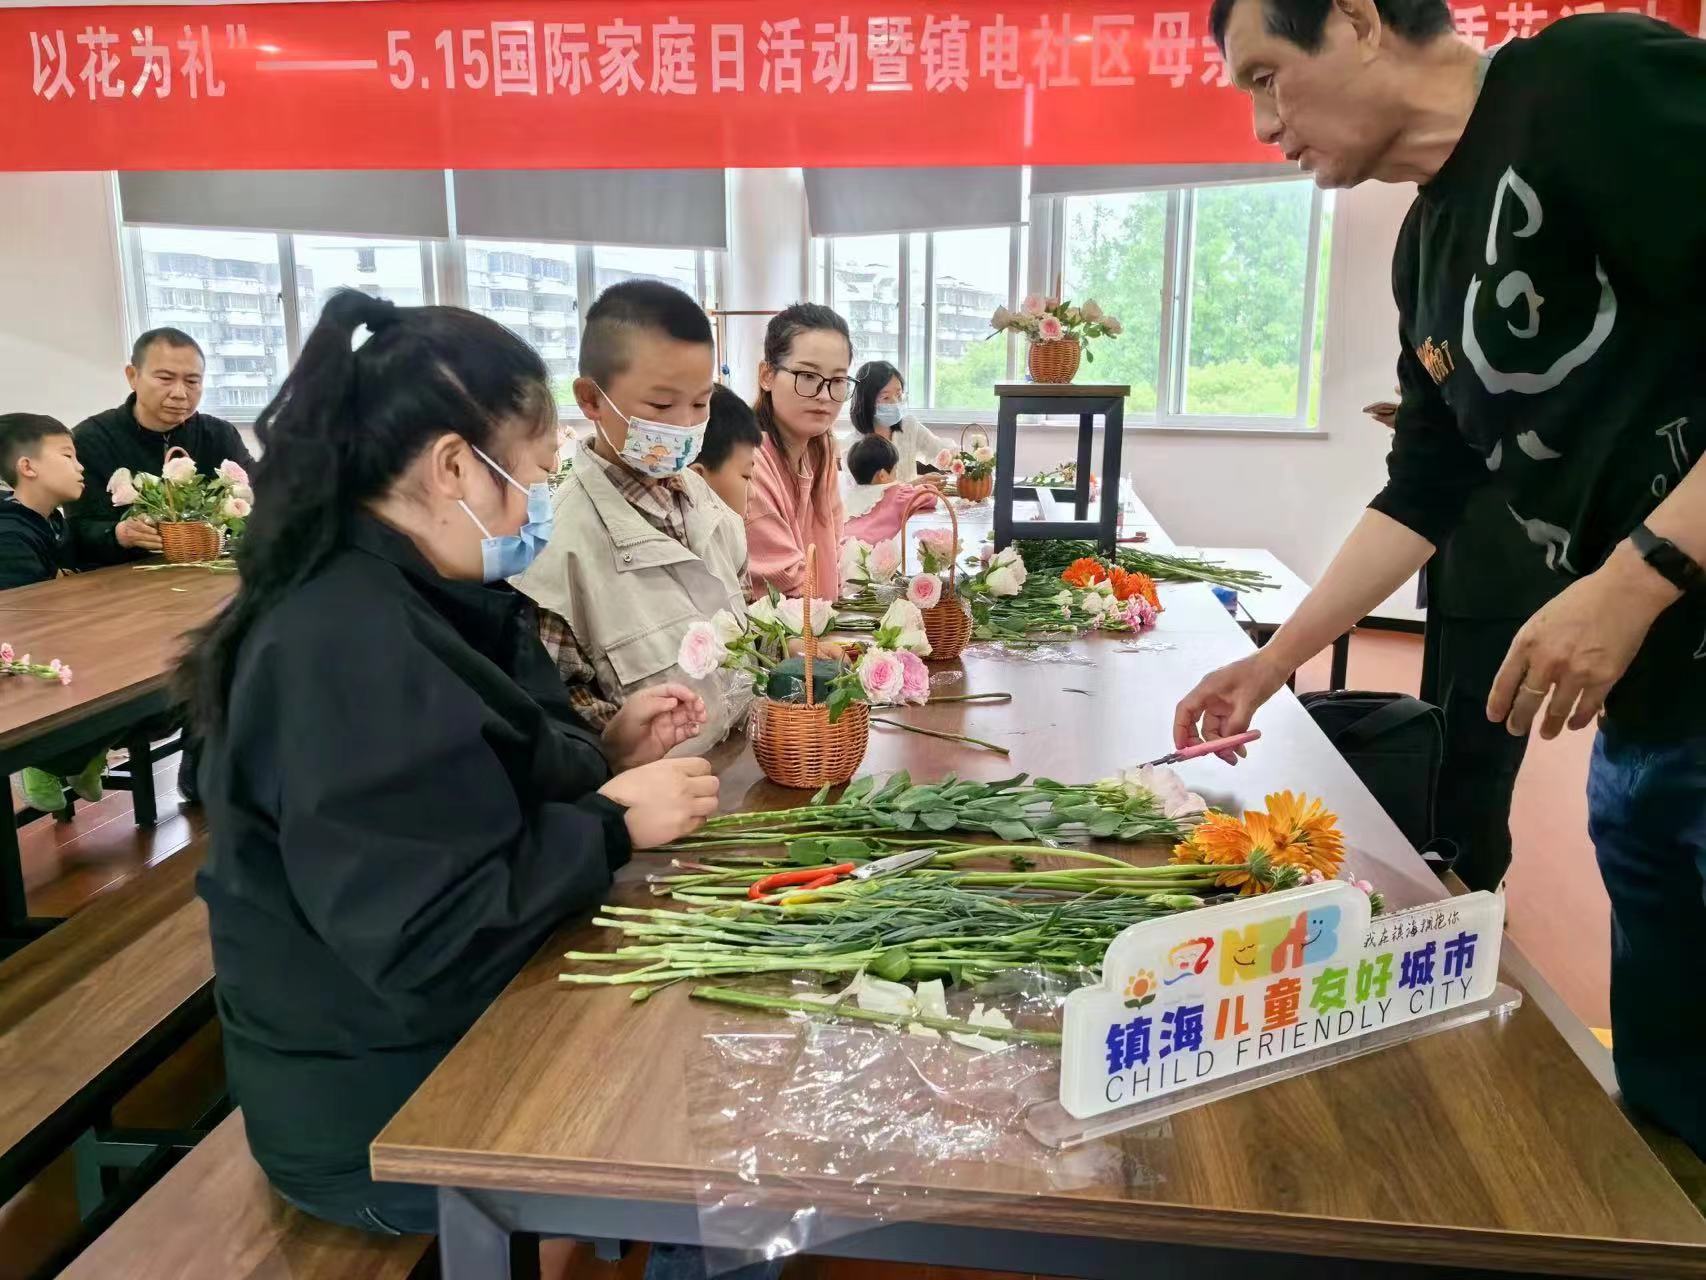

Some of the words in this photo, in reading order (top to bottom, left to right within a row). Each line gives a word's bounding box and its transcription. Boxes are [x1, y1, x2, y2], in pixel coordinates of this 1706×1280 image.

[1105, 931, 1478, 1075] 镇海儿童友好城市
[1105, 1050, 1214, 1103] CHILD
[1236, 998, 1392, 1066] FRIENDLY
[1409, 976, 1473, 1014] CITY
